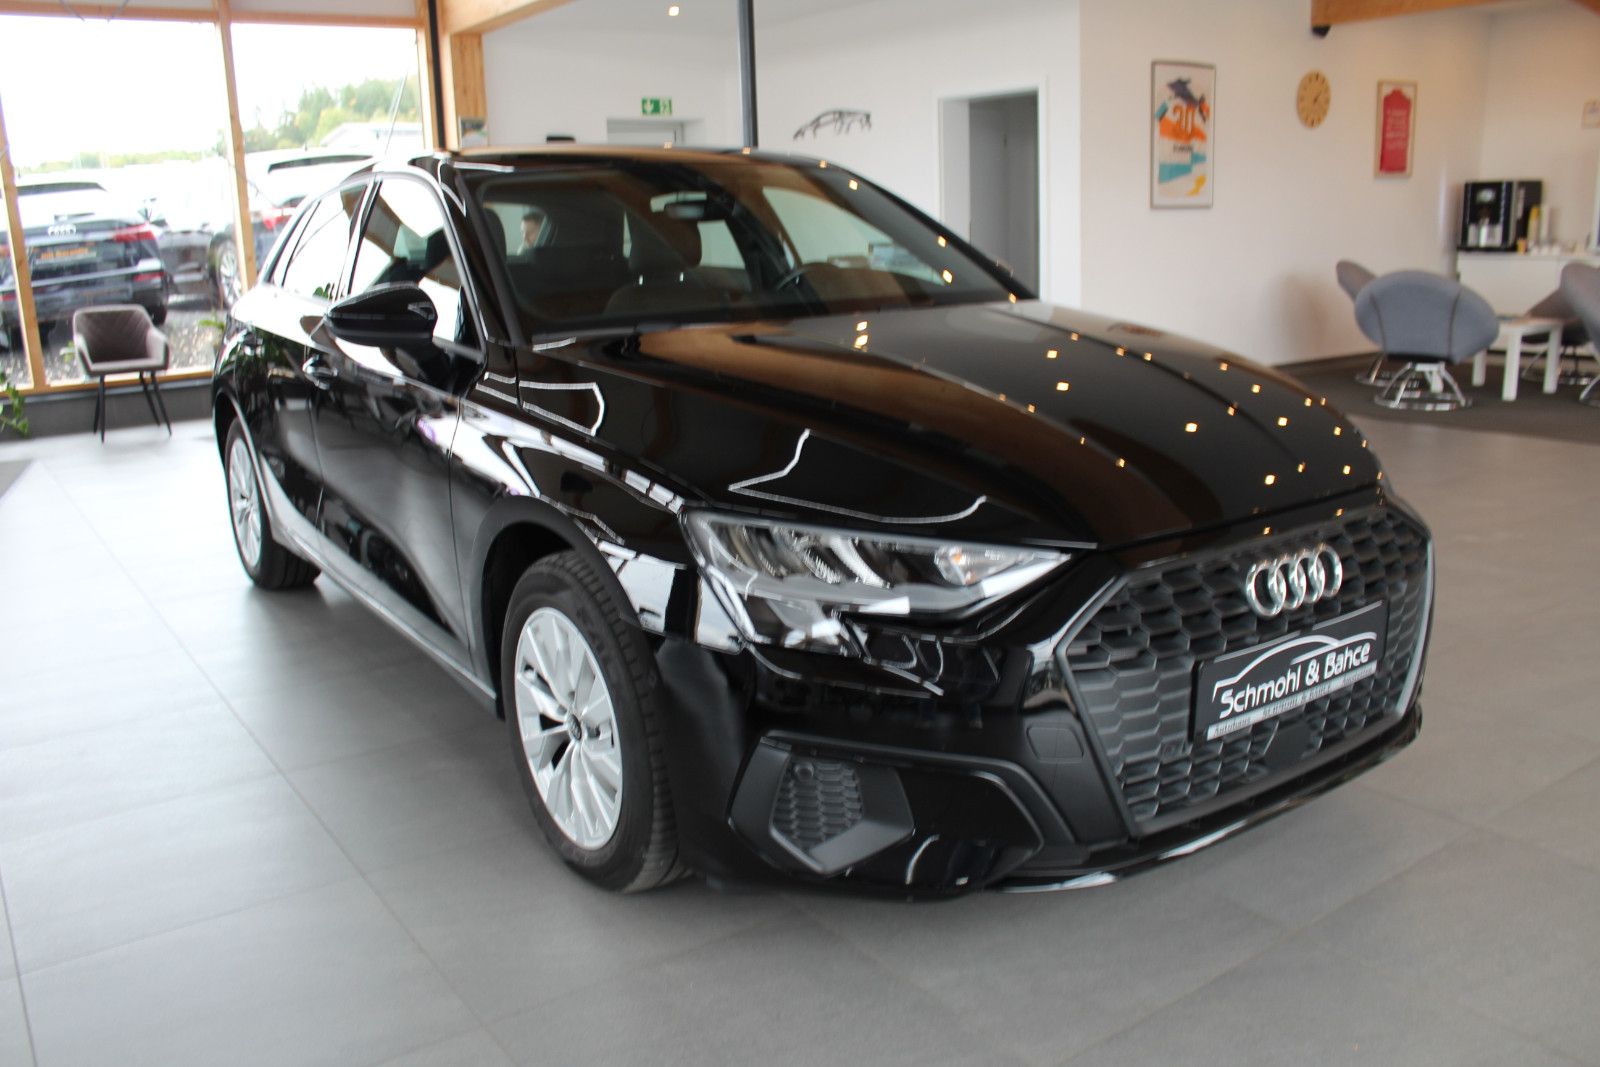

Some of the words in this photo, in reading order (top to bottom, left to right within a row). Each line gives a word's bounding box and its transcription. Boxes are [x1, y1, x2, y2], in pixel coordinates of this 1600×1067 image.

[1219, 665, 1301, 719] Schmohl
[1305, 659, 1320, 686] &
[1324, 642, 1371, 680] Bahce
